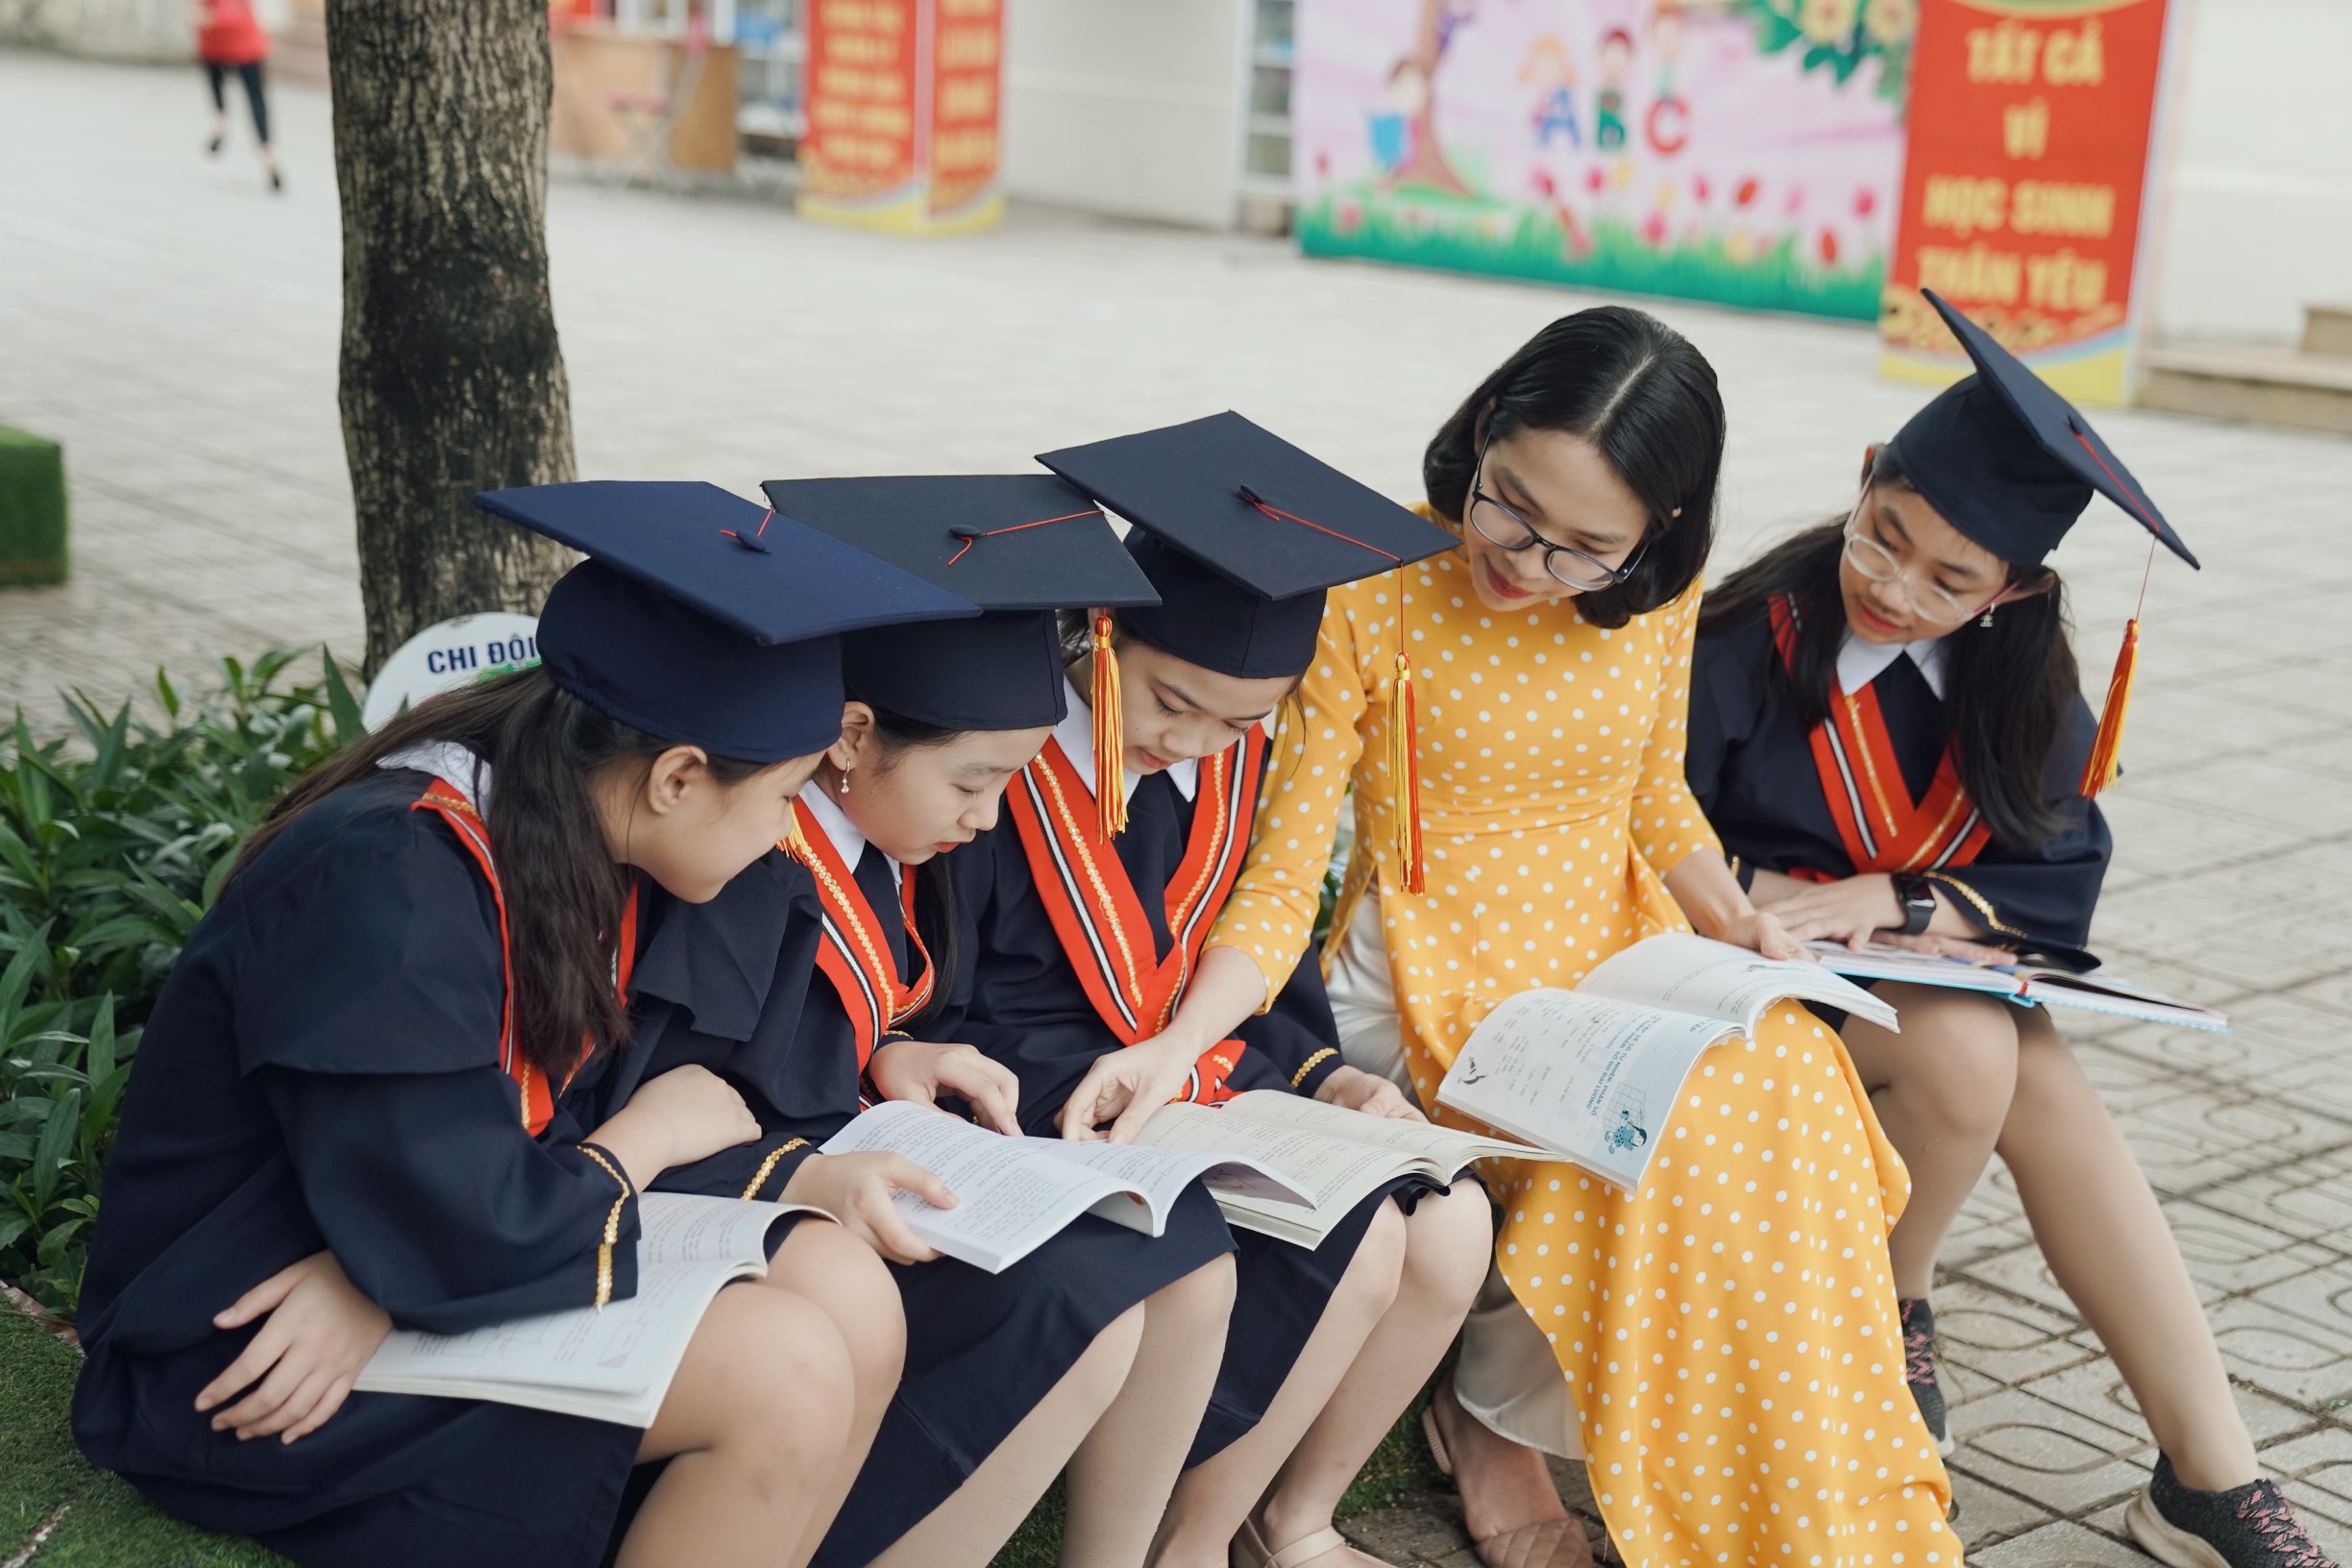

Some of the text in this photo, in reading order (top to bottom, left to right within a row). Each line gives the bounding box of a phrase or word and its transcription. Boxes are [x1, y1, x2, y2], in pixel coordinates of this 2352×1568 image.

[1923, 174, 2115, 238] HỌC SINH
[428, 646, 478, 674] CHI
